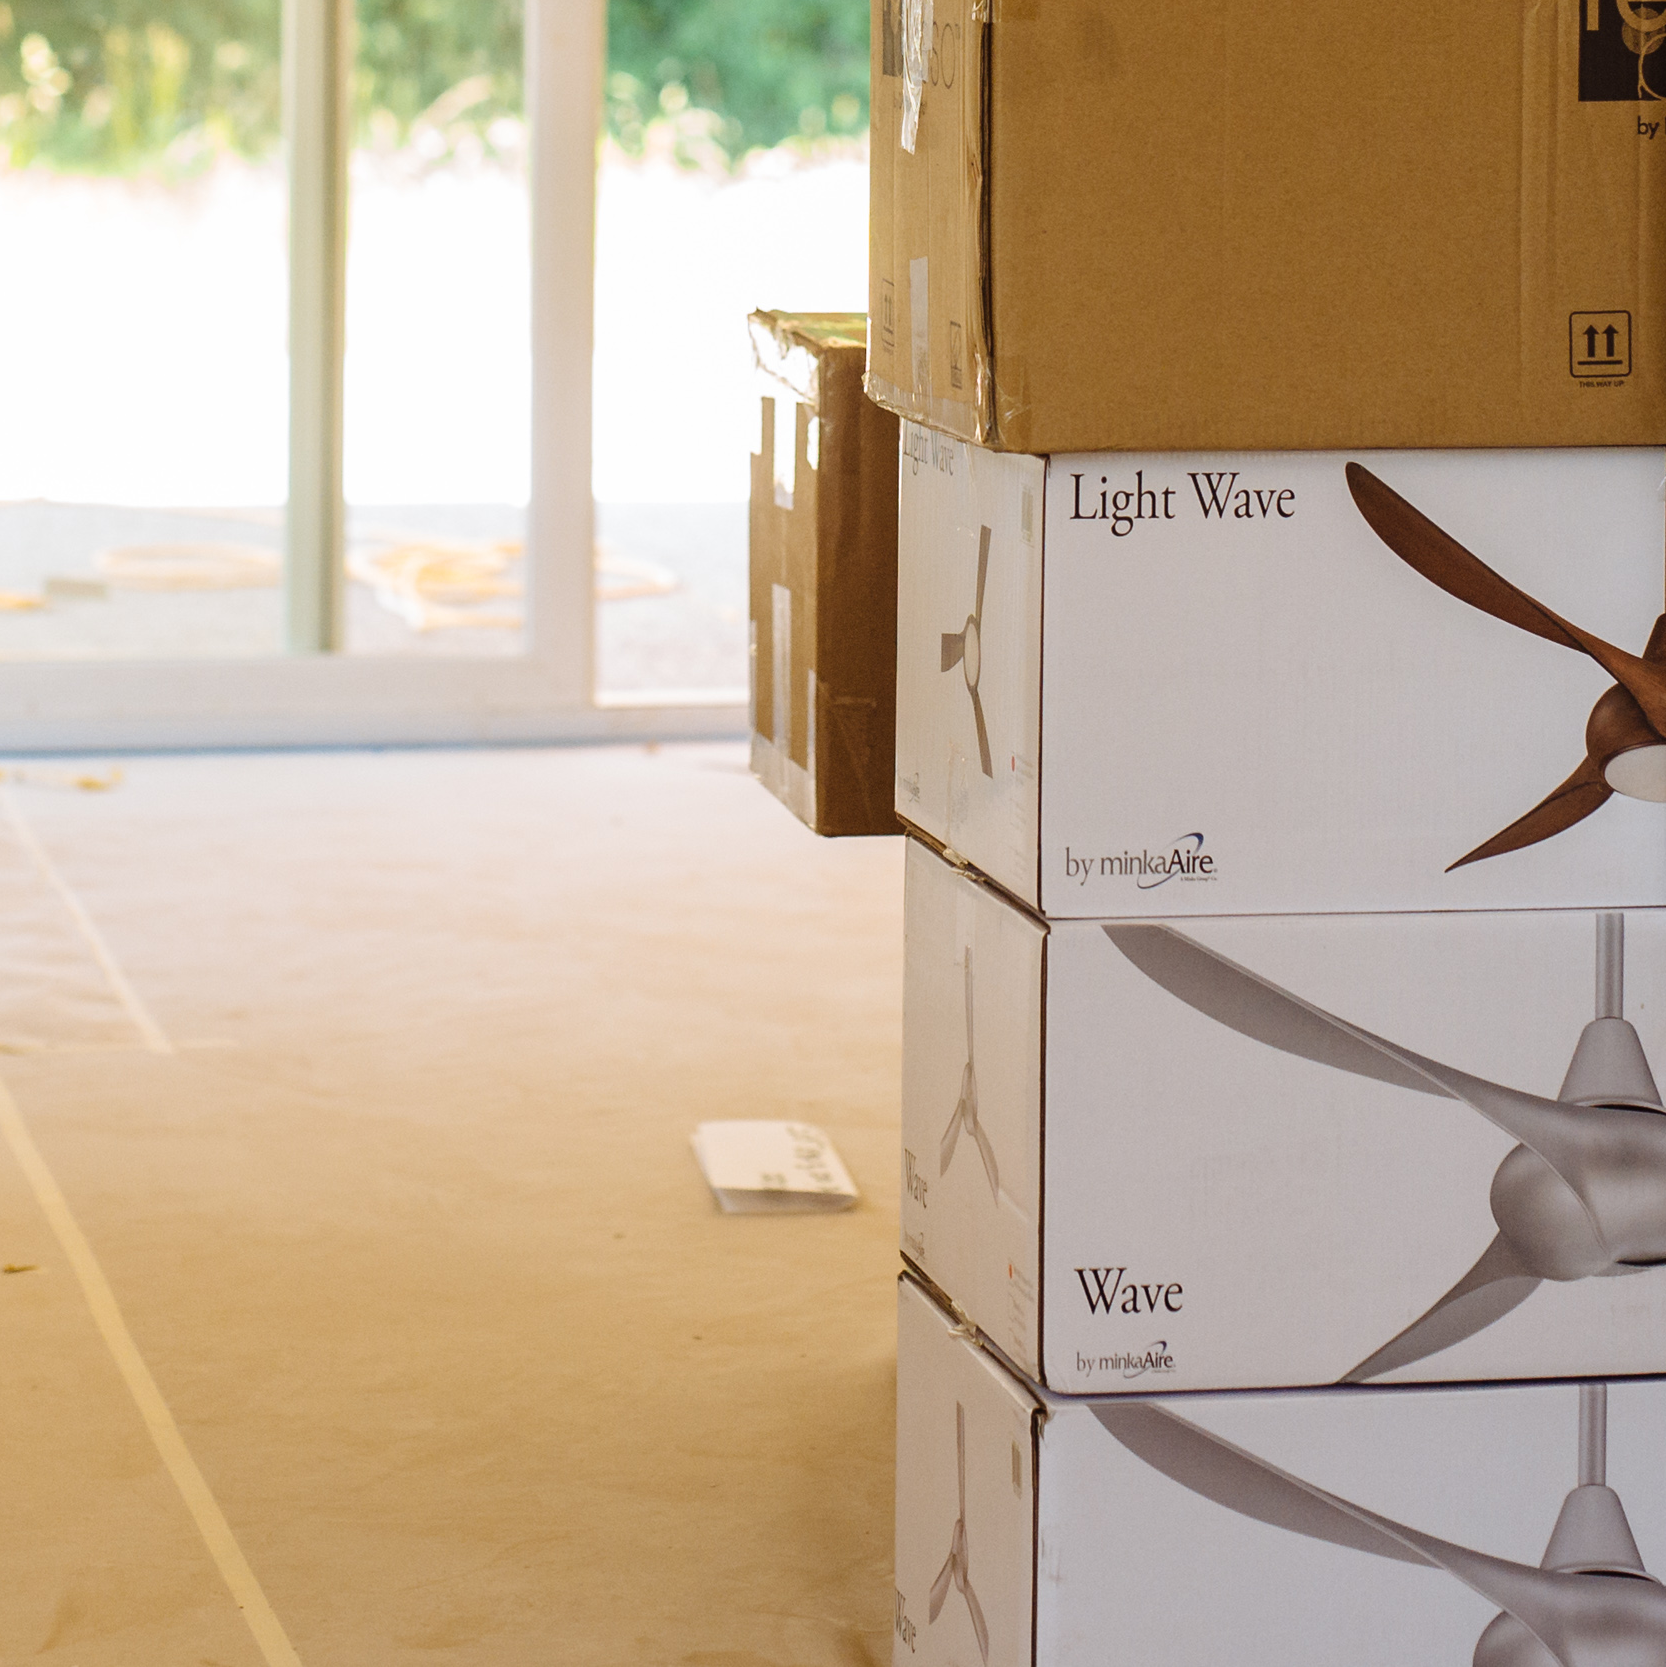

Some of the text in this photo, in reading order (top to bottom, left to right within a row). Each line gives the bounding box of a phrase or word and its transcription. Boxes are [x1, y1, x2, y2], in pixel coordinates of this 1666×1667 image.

[1638, 115, 1659, 140] by
[1070, 470, 1296, 537] Light Wave
[1065, 847, 1095, 886] by
[1074, 1267, 1183, 1315] Wave
[1077, 1351, 1095, 1377] by
